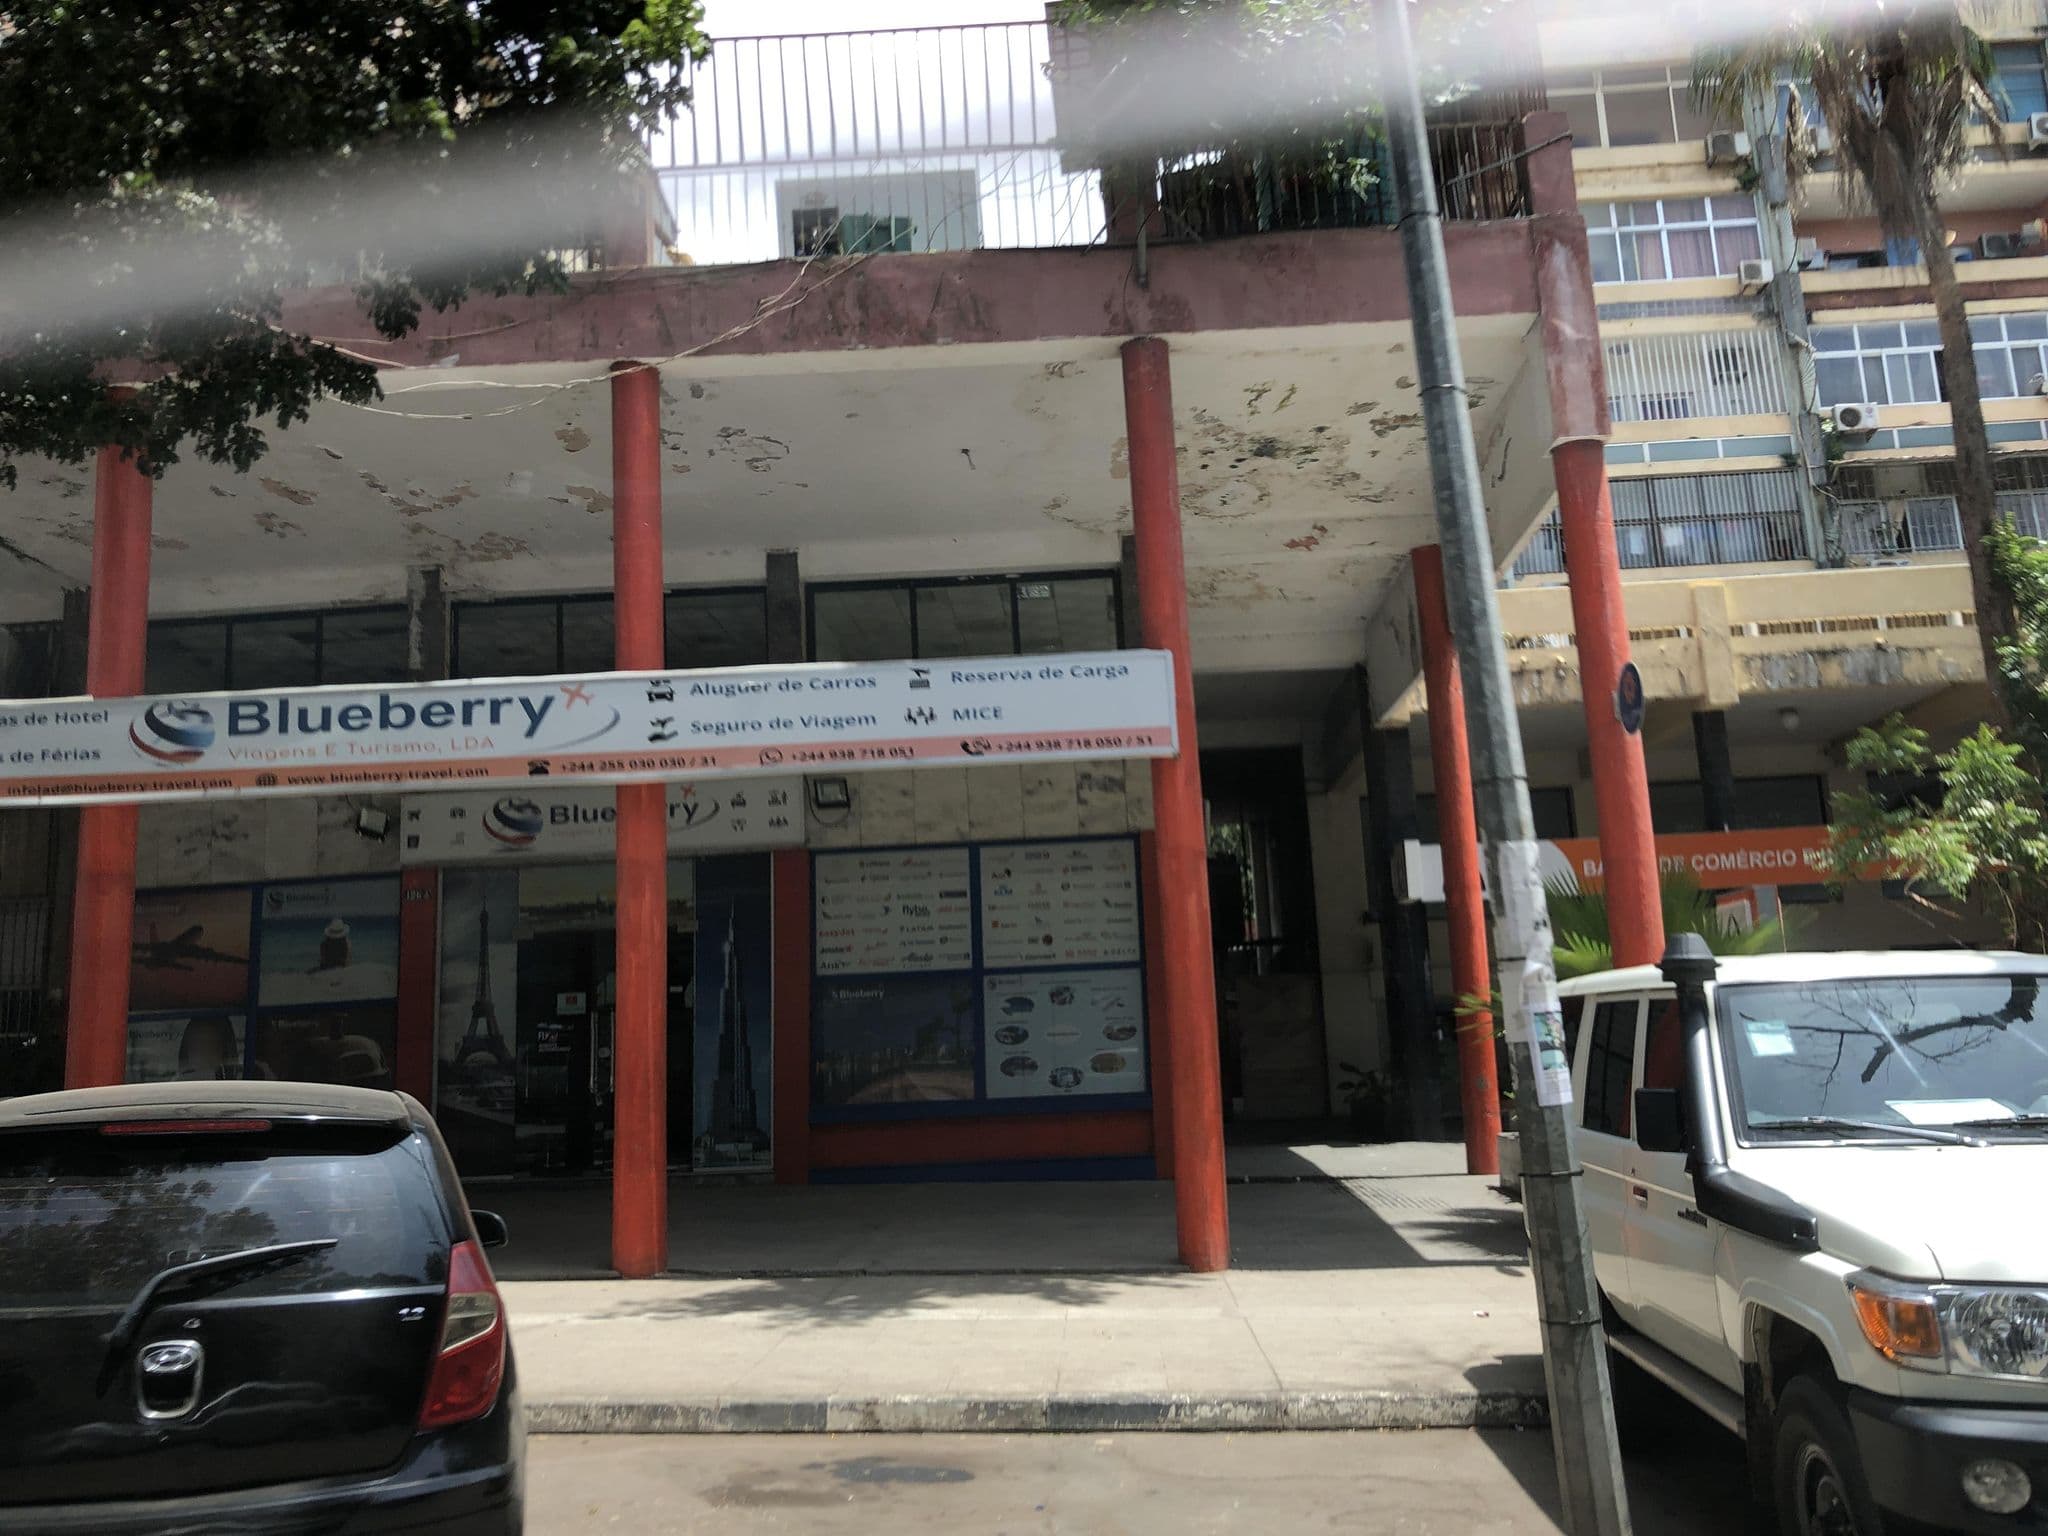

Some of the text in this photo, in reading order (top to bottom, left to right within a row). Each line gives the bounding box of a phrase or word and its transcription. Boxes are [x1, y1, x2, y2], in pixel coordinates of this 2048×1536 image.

[951, 663, 1130, 685] Reserva de Carga
[689, 676, 877, 699] Aluguer de Carros
[24, 711, 48, 726] de
[54, 709, 109, 724] Hotel
[228, 692, 555, 739] Blueberry
[690, 712, 877, 737] Seguro de Viagem
[952, 706, 1004, 721] MICE
[9, 750, 35, 764] de
[41, 746, 101, 763] Férias
[226, 743, 317, 762] Viagens
[325, 744, 337, 757] E
[451, 735, 495, 752] LDA
[1690, 847, 1797, 873] COMÉRCIO
